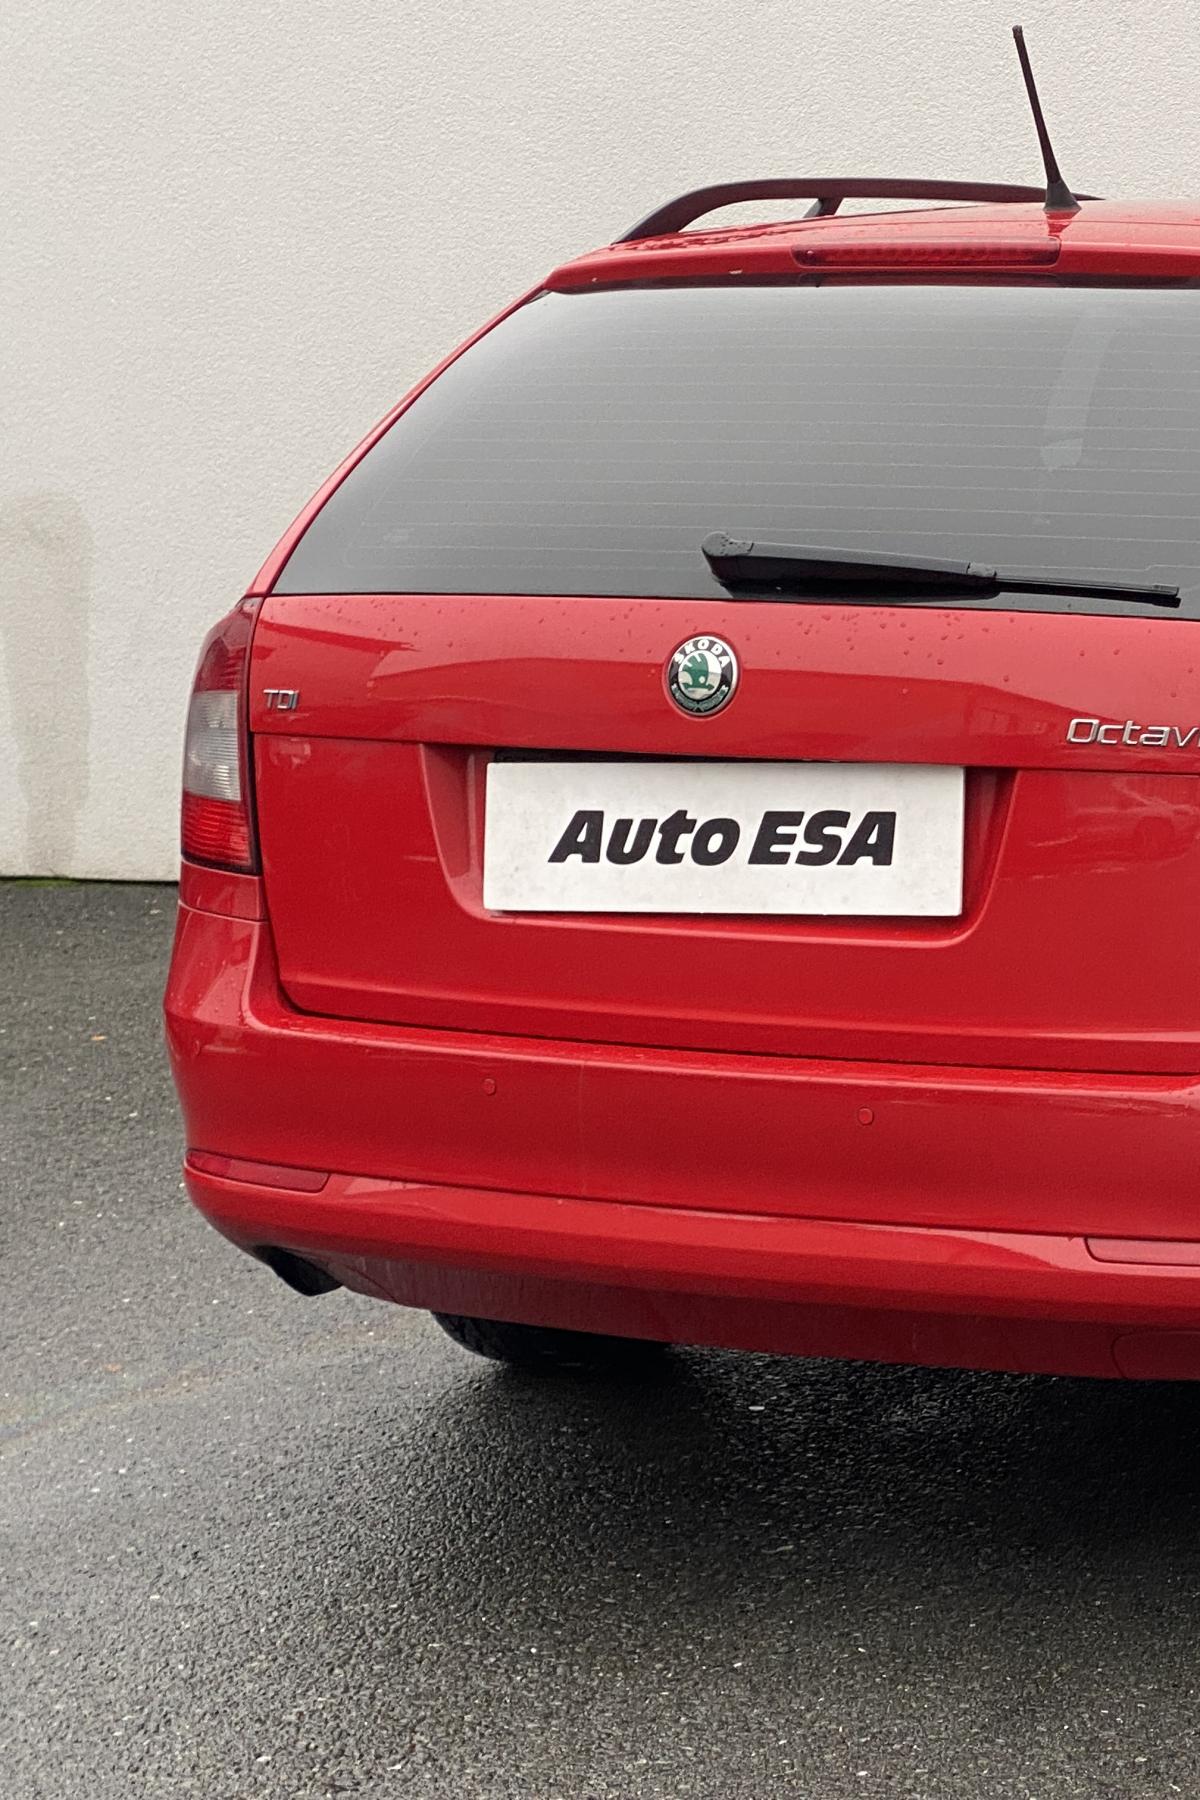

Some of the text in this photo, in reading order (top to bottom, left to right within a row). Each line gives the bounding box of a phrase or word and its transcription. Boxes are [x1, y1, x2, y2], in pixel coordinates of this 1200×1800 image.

[263, 689, 299, 709] TDI
[547, 809, 897, 867] Auto ESA
